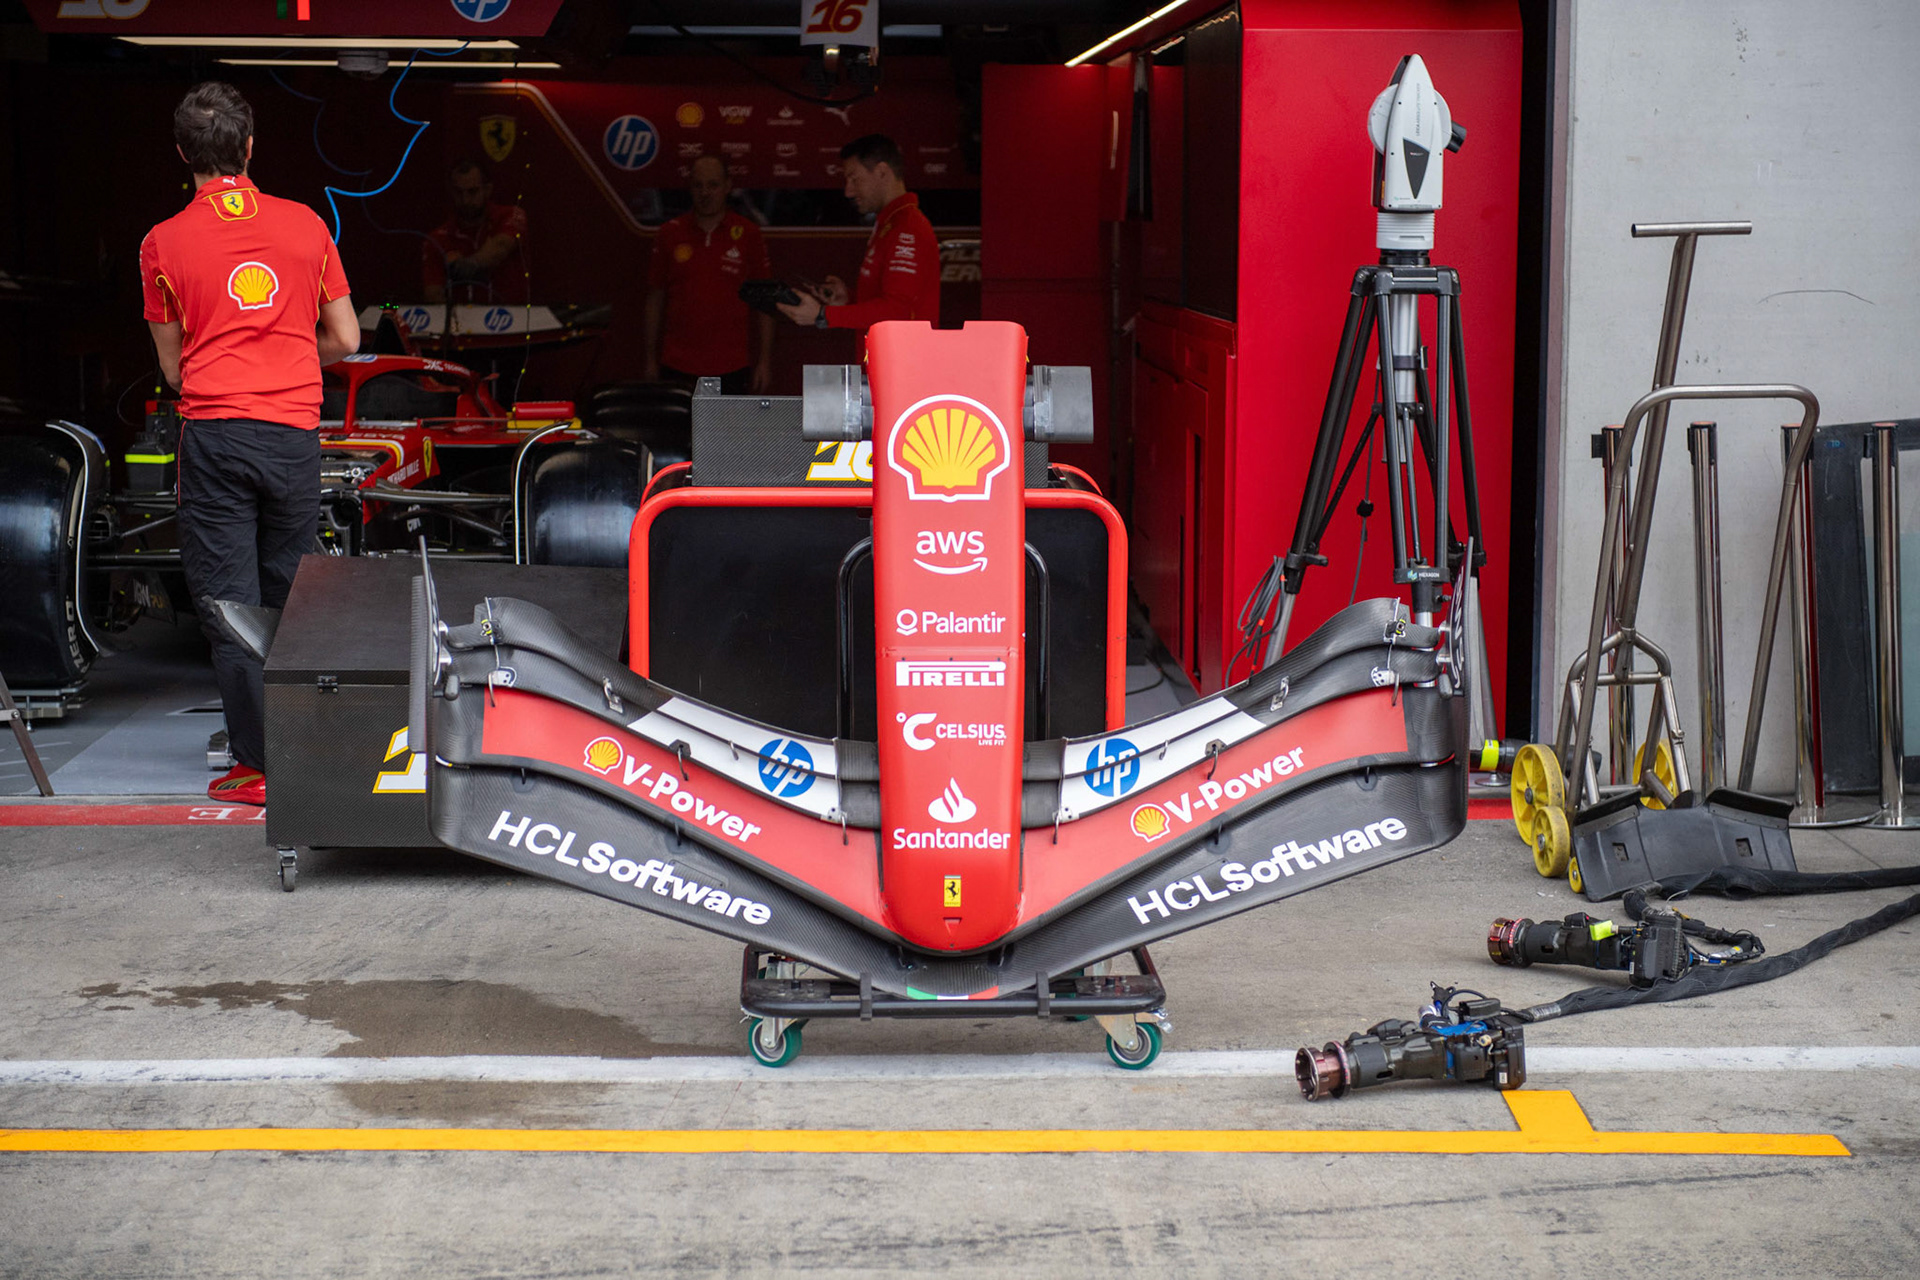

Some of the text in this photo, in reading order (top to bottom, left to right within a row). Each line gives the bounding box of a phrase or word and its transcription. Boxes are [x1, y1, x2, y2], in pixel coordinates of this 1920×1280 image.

[806, 0, 868, 33] 16
[611, 116, 651, 169] hp
[485, 308, 513, 330] hp
[915, 530, 985, 555] aws
[922, 610, 1006, 634] Palantir
[896, 660, 1006, 686] PIRELLI
[936, 723, 1006, 739] CELSIUS
[761, 738, 813, 798] hp
[1088, 738, 1140, 798] hp
[1164, 746, 1305, 823] V-Power
[622, 754, 761, 844] V-Power
[893, 827, 1011, 850] Santander
[488, 810, 771, 925] HCLSoftware
[1127, 817, 1407, 925] HCLSoftware
